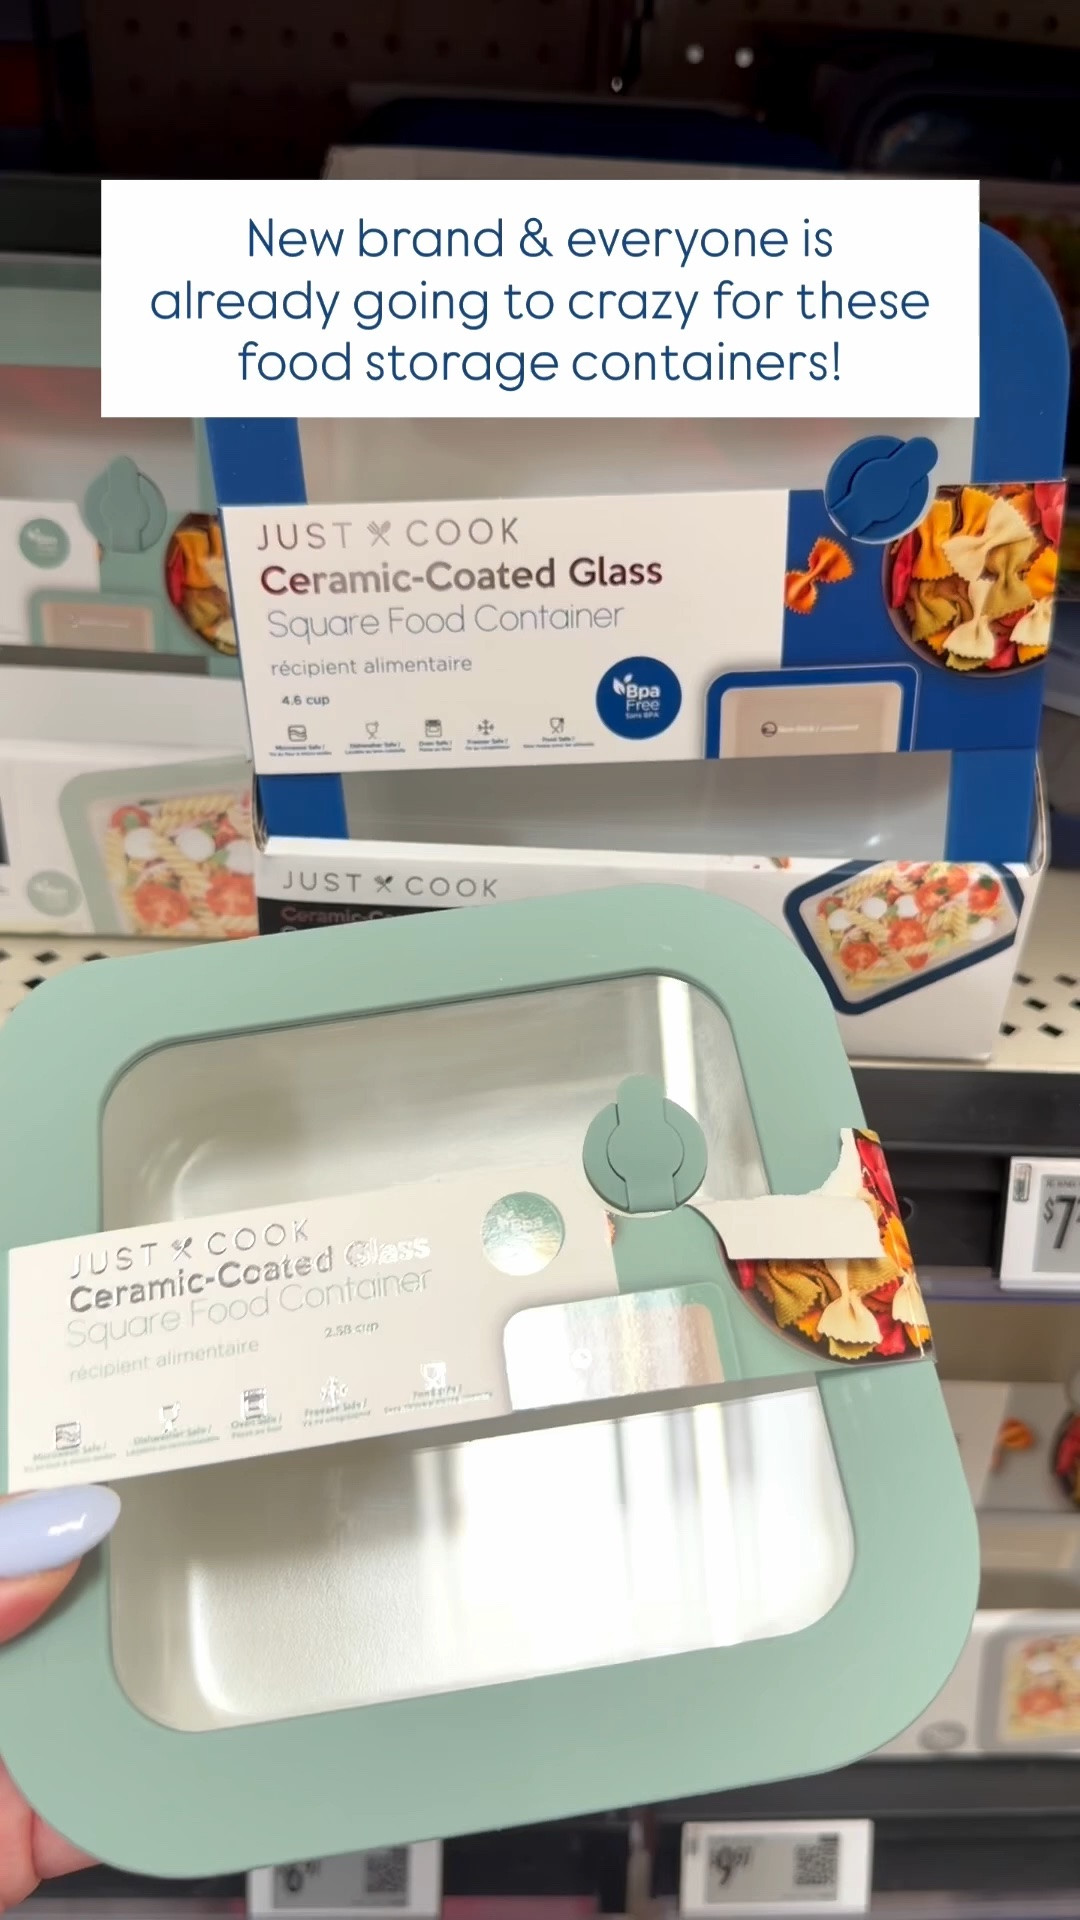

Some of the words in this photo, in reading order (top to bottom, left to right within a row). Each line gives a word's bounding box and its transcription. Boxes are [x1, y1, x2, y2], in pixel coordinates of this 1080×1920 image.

[257, 522, 352, 551] JUST
[406, 517, 519, 547] COOK
[260, 558, 556, 596] Ceramic-Coated
[568, 556, 663, 589] Glass
[267, 609, 380, 645] Square
[389, 604, 466, 635] Food
[474, 604, 625, 632] Container
[271, 657, 357, 678] récipient
[363, 656, 472, 675] alimentaire
[306, 696, 330, 707] cup
[626, 684, 660, 700] Bpa
[626, 699, 660, 711] Free
[282, 870, 362, 893] JUST
[405, 876, 498, 899] COOK
[70, 1242, 158, 1279] JUST
[207, 1218, 308, 1256] COOK
[70, 1245, 333, 1313] Ceramic-Coated
[344, 1237, 432, 1267] Glass
[67, 1311, 181, 1350] Square
[191, 1288, 269, 1328] Food
[279, 1269, 432, 1312] Container
[70, 1355, 150, 1383] récipient
[156, 1339, 260, 1368] alimentaire
